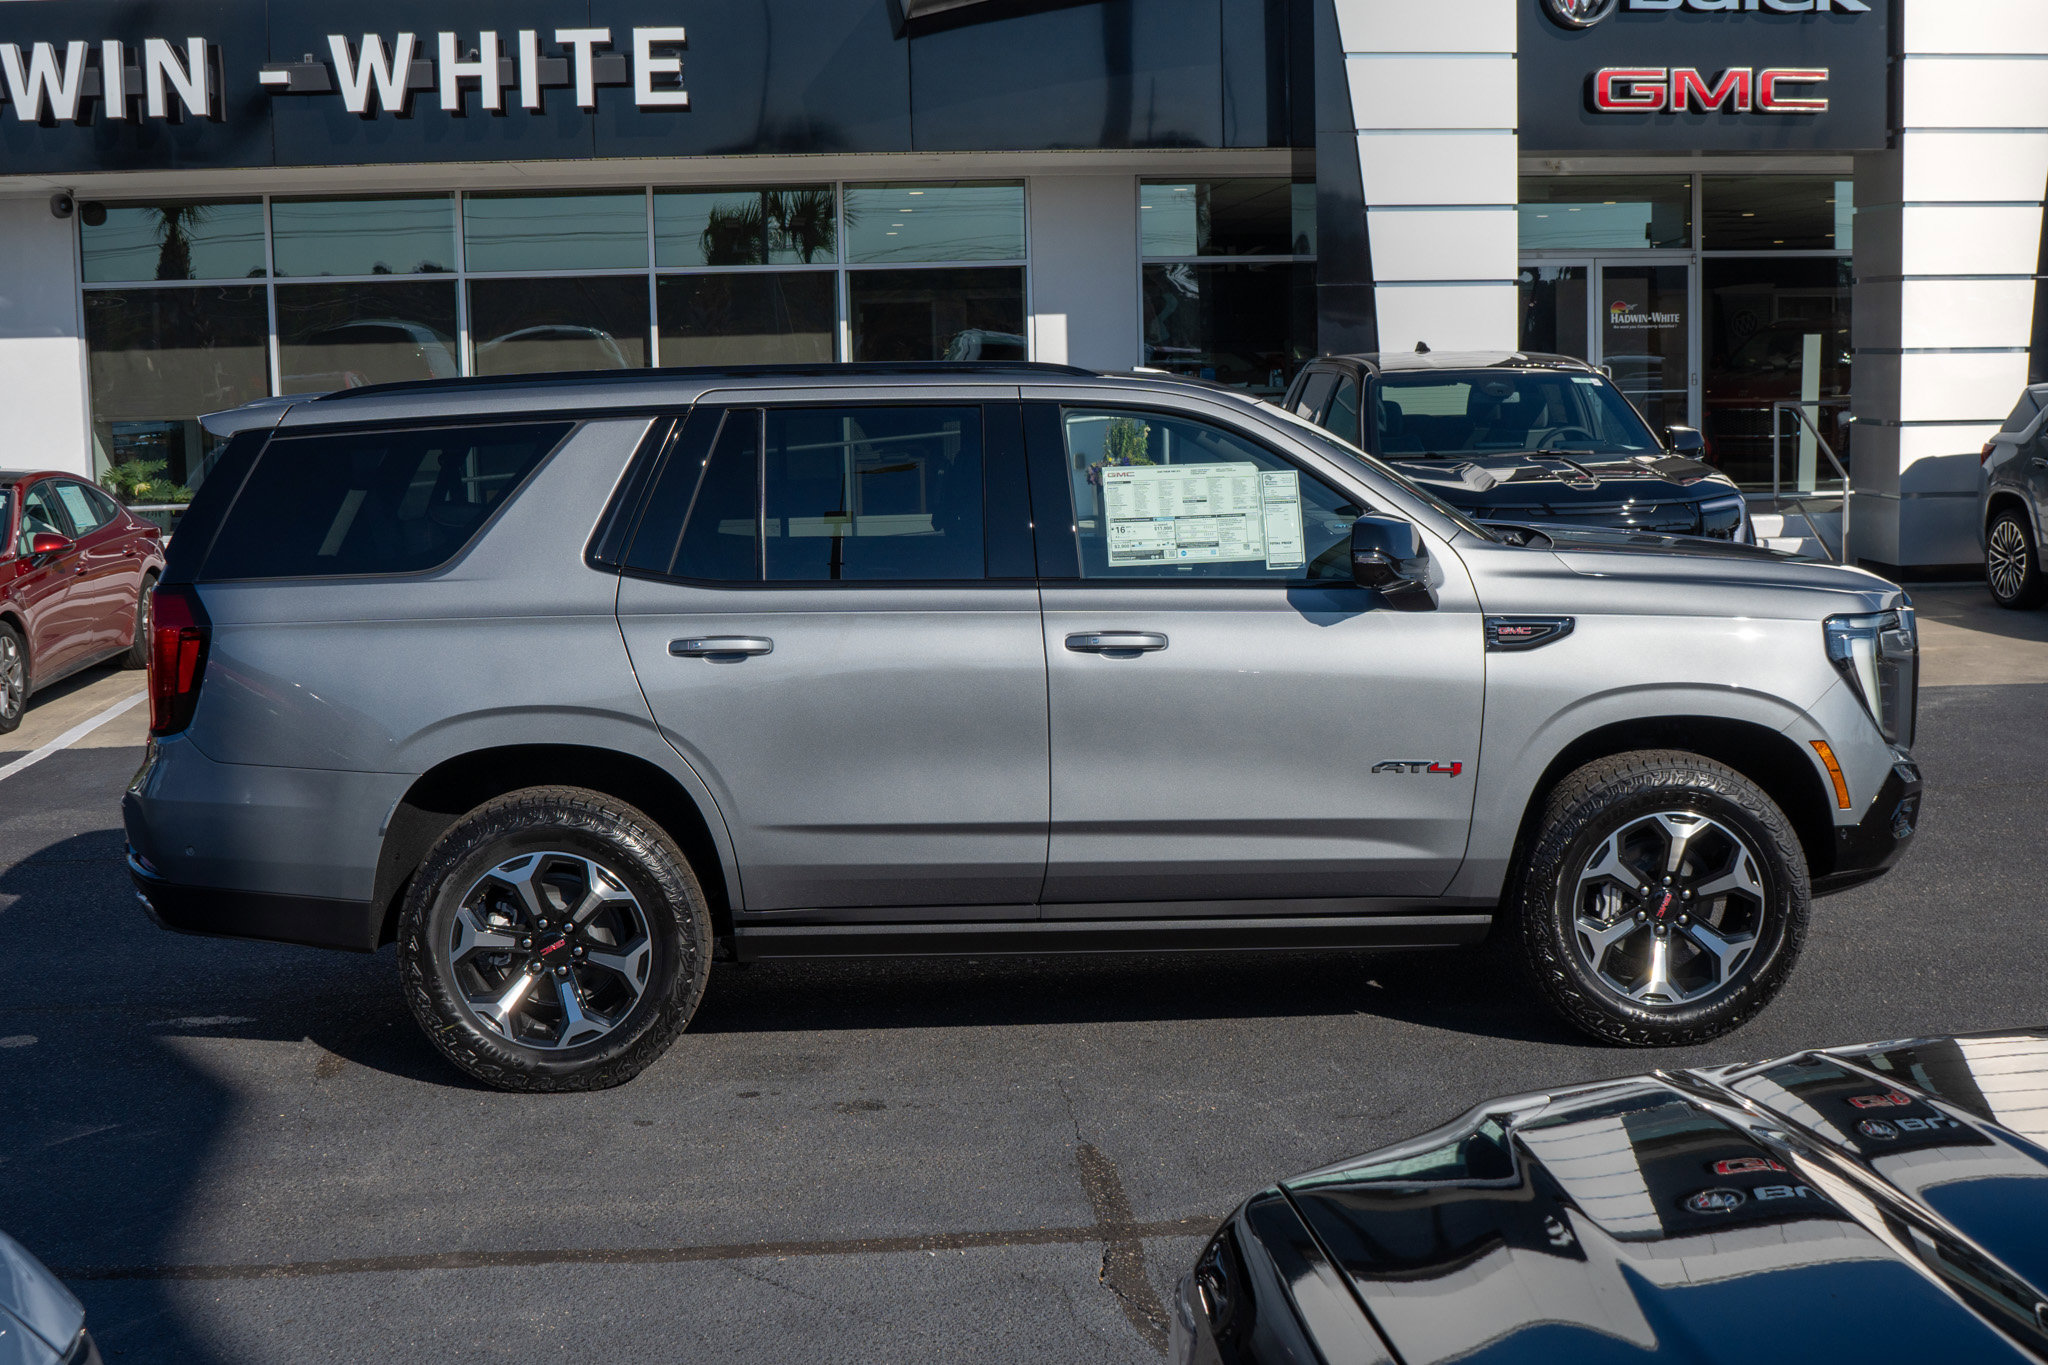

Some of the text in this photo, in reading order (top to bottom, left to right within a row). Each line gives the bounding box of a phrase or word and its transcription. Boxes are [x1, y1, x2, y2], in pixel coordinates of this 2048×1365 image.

[327, 27, 688, 113] WHITE
[1594, 67, 1829, 113] GMC
[1116, 526, 1126, 534] 16
[1498, 626, 1531, 635] GMC
[1371, 759, 1463, 778] AT4
[1656, 893, 1672, 918] GMC
[540, 939, 565, 956] GMC
